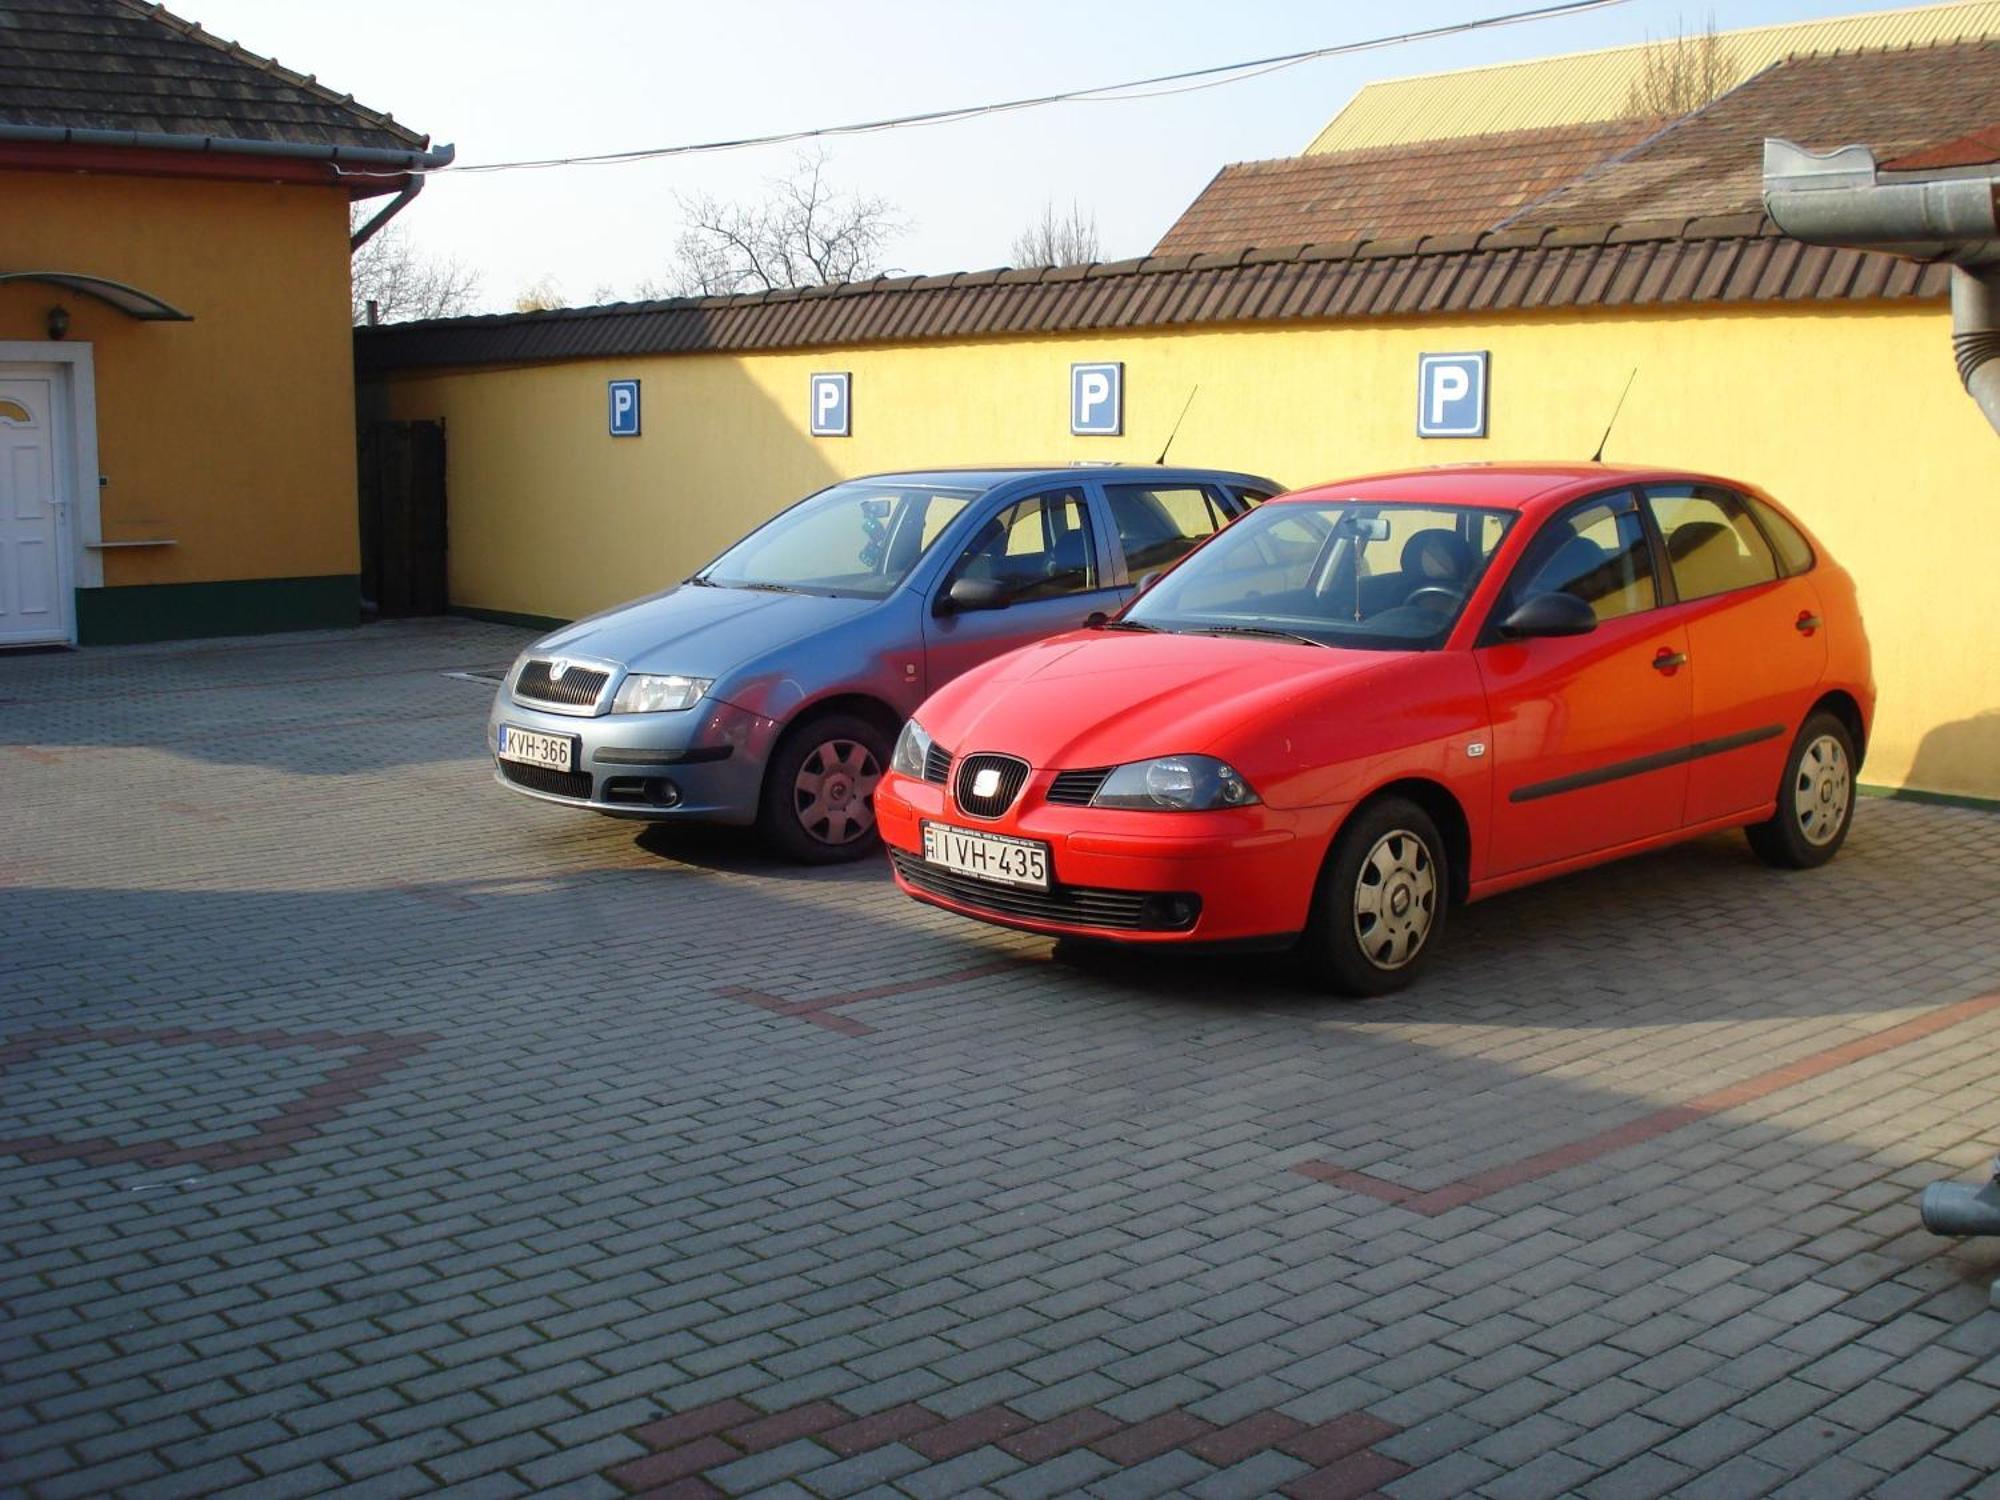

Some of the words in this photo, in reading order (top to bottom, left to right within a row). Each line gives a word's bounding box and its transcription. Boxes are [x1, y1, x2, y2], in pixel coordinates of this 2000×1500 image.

[616, 389, 631, 426] P
[819, 383, 839, 426] P
[1081, 374, 1109, 423] P
[1432, 366, 1469, 423] P
[508, 731, 568, 763] KVH-366
[926, 845, 935, 859] H
[944, 834, 1044, 880] IVH-435
